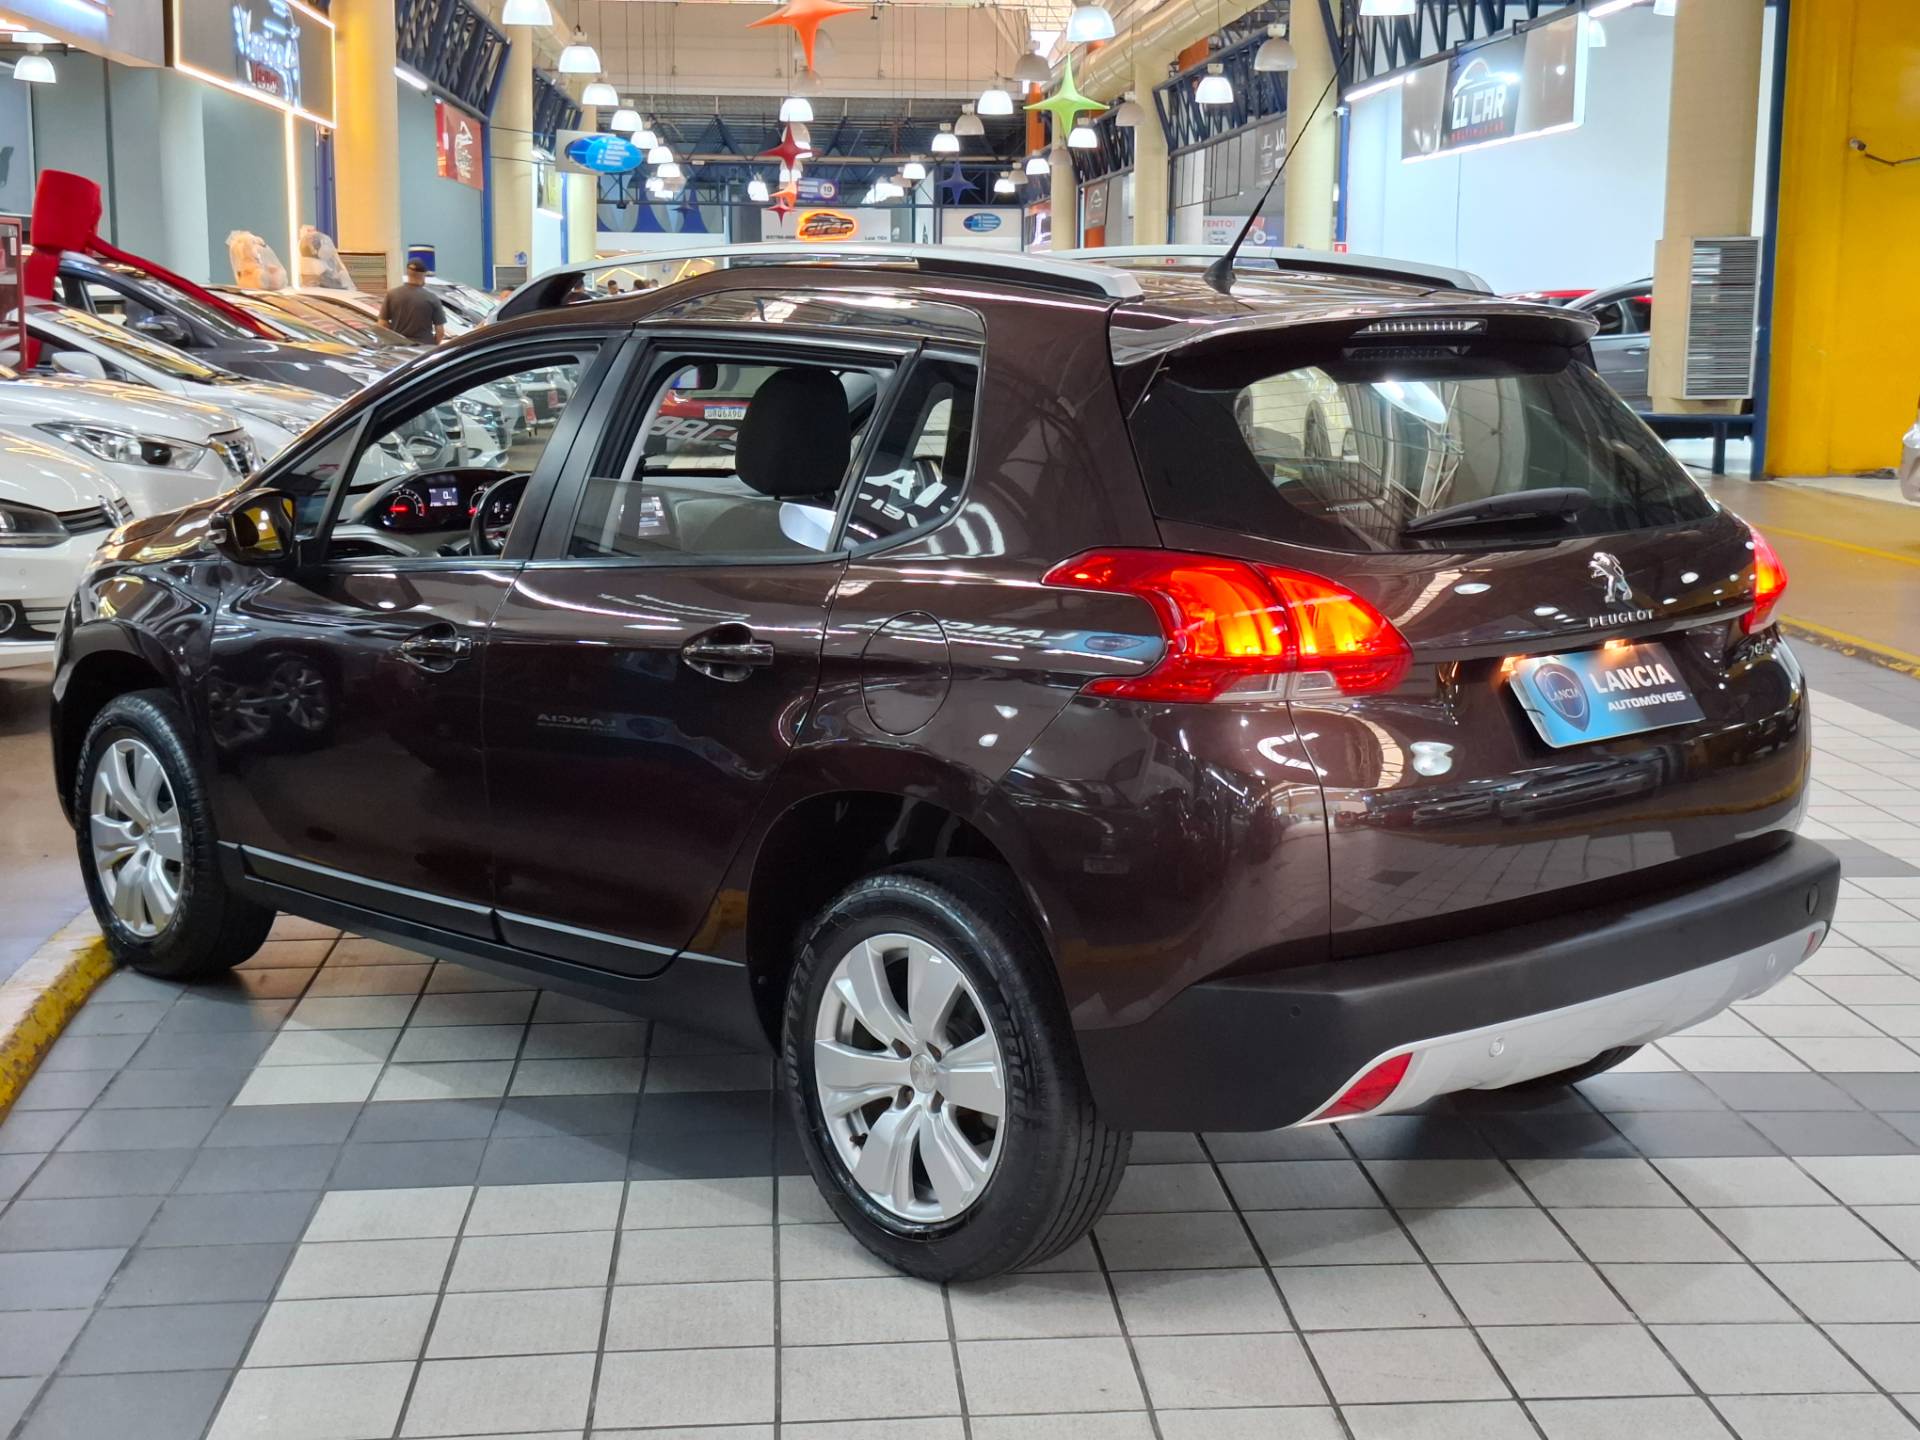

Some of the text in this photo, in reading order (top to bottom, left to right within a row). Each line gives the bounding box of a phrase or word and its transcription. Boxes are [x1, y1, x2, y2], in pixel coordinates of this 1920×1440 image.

[1472, 86, 1507, 123] CAR
[1588, 609, 1655, 629] PEUGEOT
[1588, 663, 1676, 694] LANCIA
[1546, 687, 1582, 702] LANCIA
[1607, 690, 1687, 712] AUTOMÓVEIS
